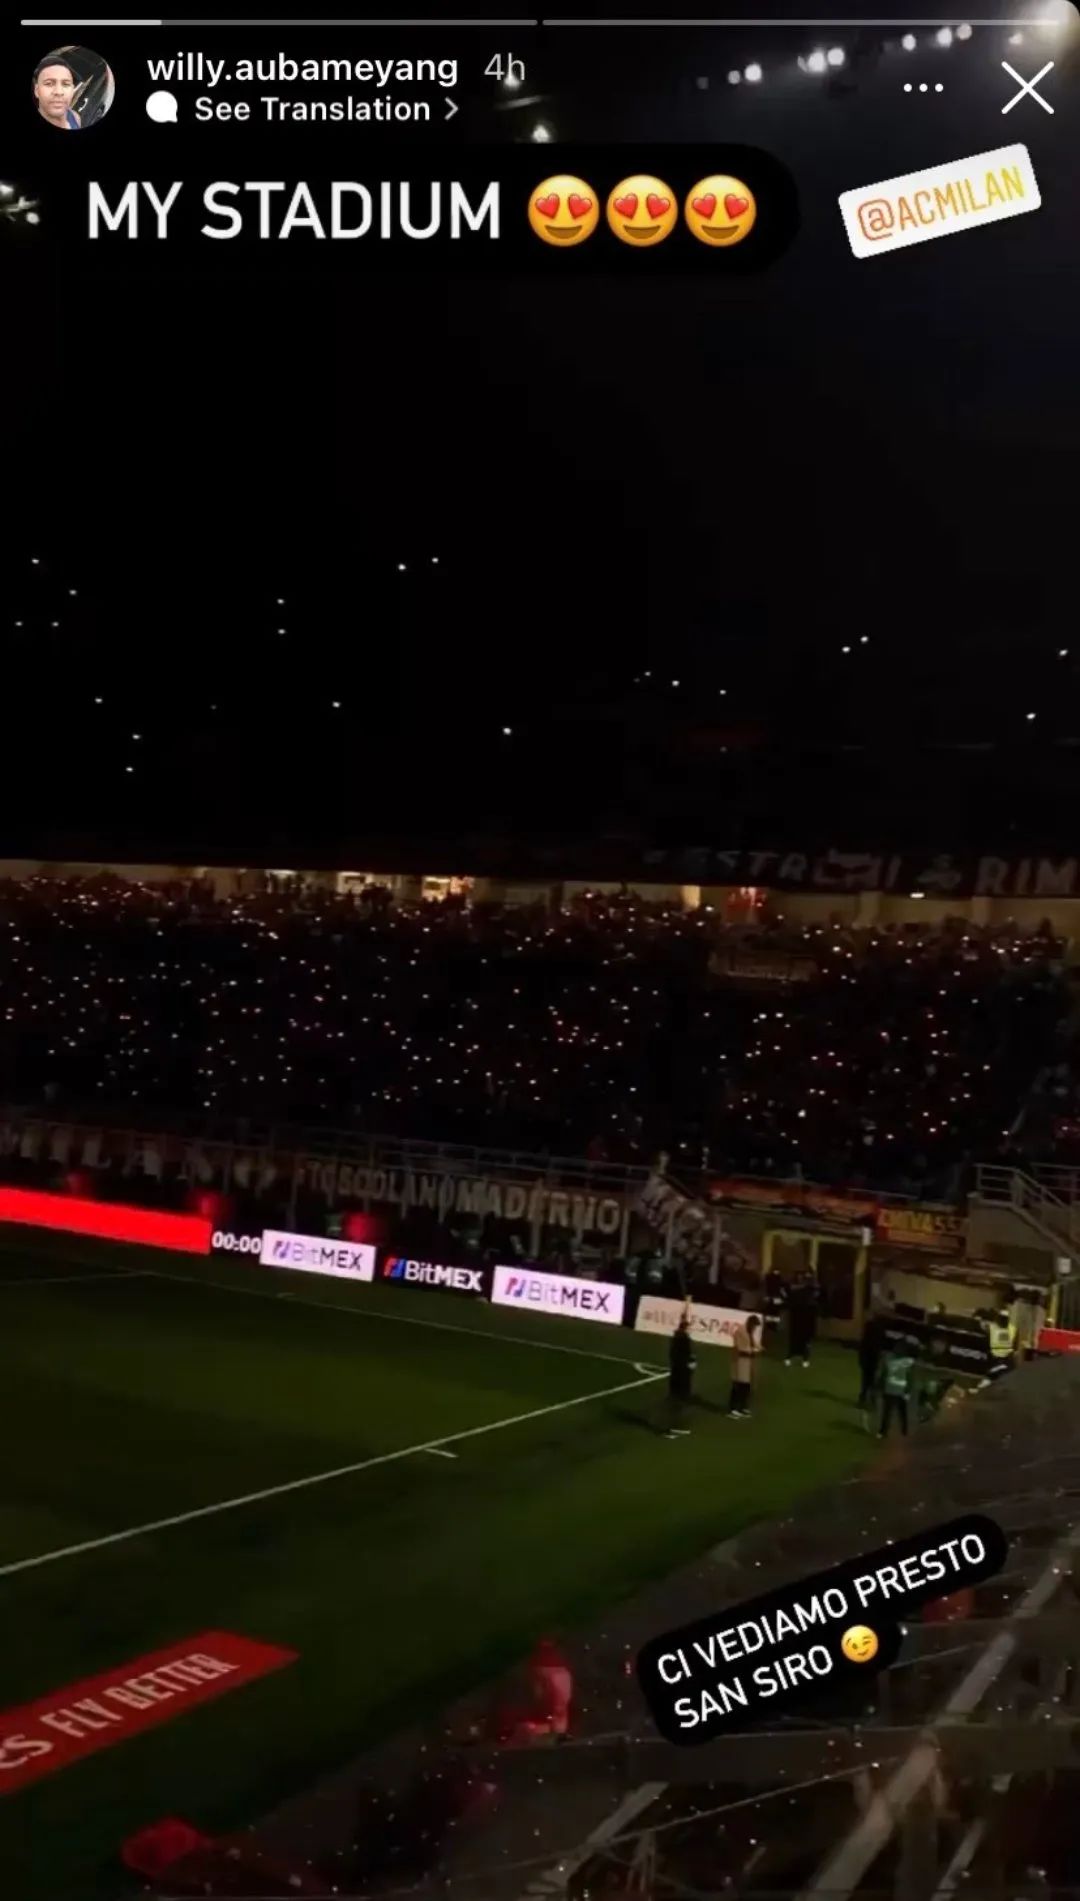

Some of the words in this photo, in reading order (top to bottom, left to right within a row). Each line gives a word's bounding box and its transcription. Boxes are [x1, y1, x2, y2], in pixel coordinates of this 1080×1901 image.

[210, 1230, 262, 1255] 00:00
[291, 1243, 364, 1271] BitMEX
[404, 1259, 484, 1292] BitMEX
[527, 1283, 611, 1313] BitMEX
[39, 1697, 124, 1738] FLY
[102, 1652, 241, 1710] BETTER
